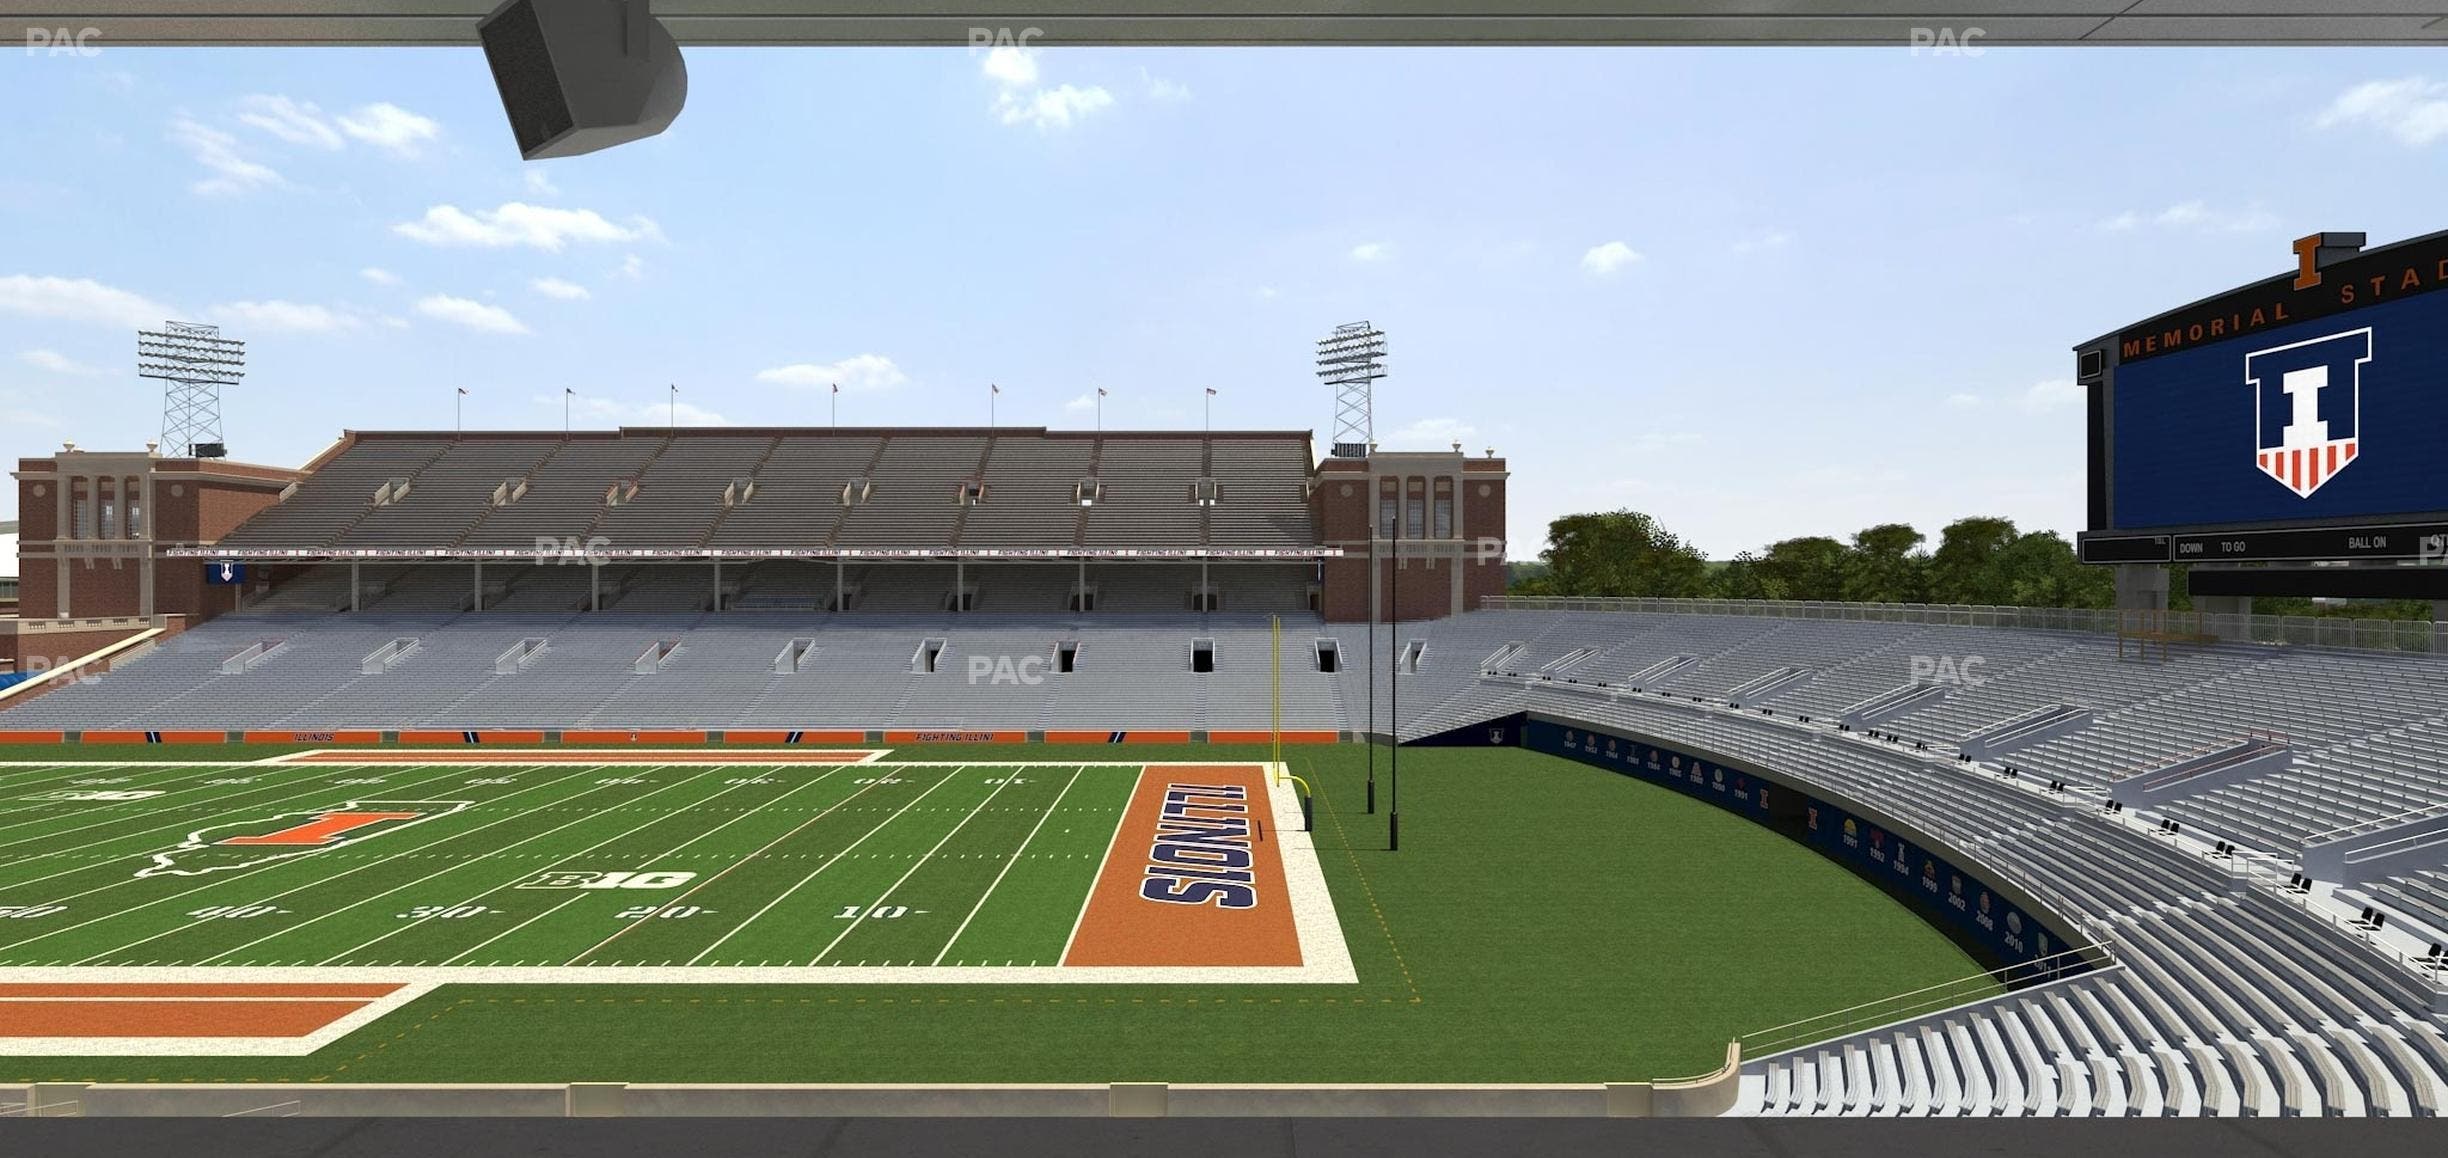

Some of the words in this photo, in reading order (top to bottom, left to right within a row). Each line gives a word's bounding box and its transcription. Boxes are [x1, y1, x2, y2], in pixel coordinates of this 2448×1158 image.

[2123, 302, 2289, 358] MEMORIAL
[2180, 542, 2203, 554] DOWN
[2221, 541, 2232, 552] TO
[2233, 541, 2246, 552] GO
[2348, 537, 2372, 549] BALL
[2373, 535, 2387, 548] ON
[294, 733, 335, 741] ILLINOIS
[916, 733, 962, 741] FIGHTING
[965, 733, 994, 741] ILLINI
[1138, 782, 1259, 909] ILLINOIS
[614, 905, 700, 918] 20
[833, 905, 909, 918] 10
[2004, 930, 2024, 953] 2010
